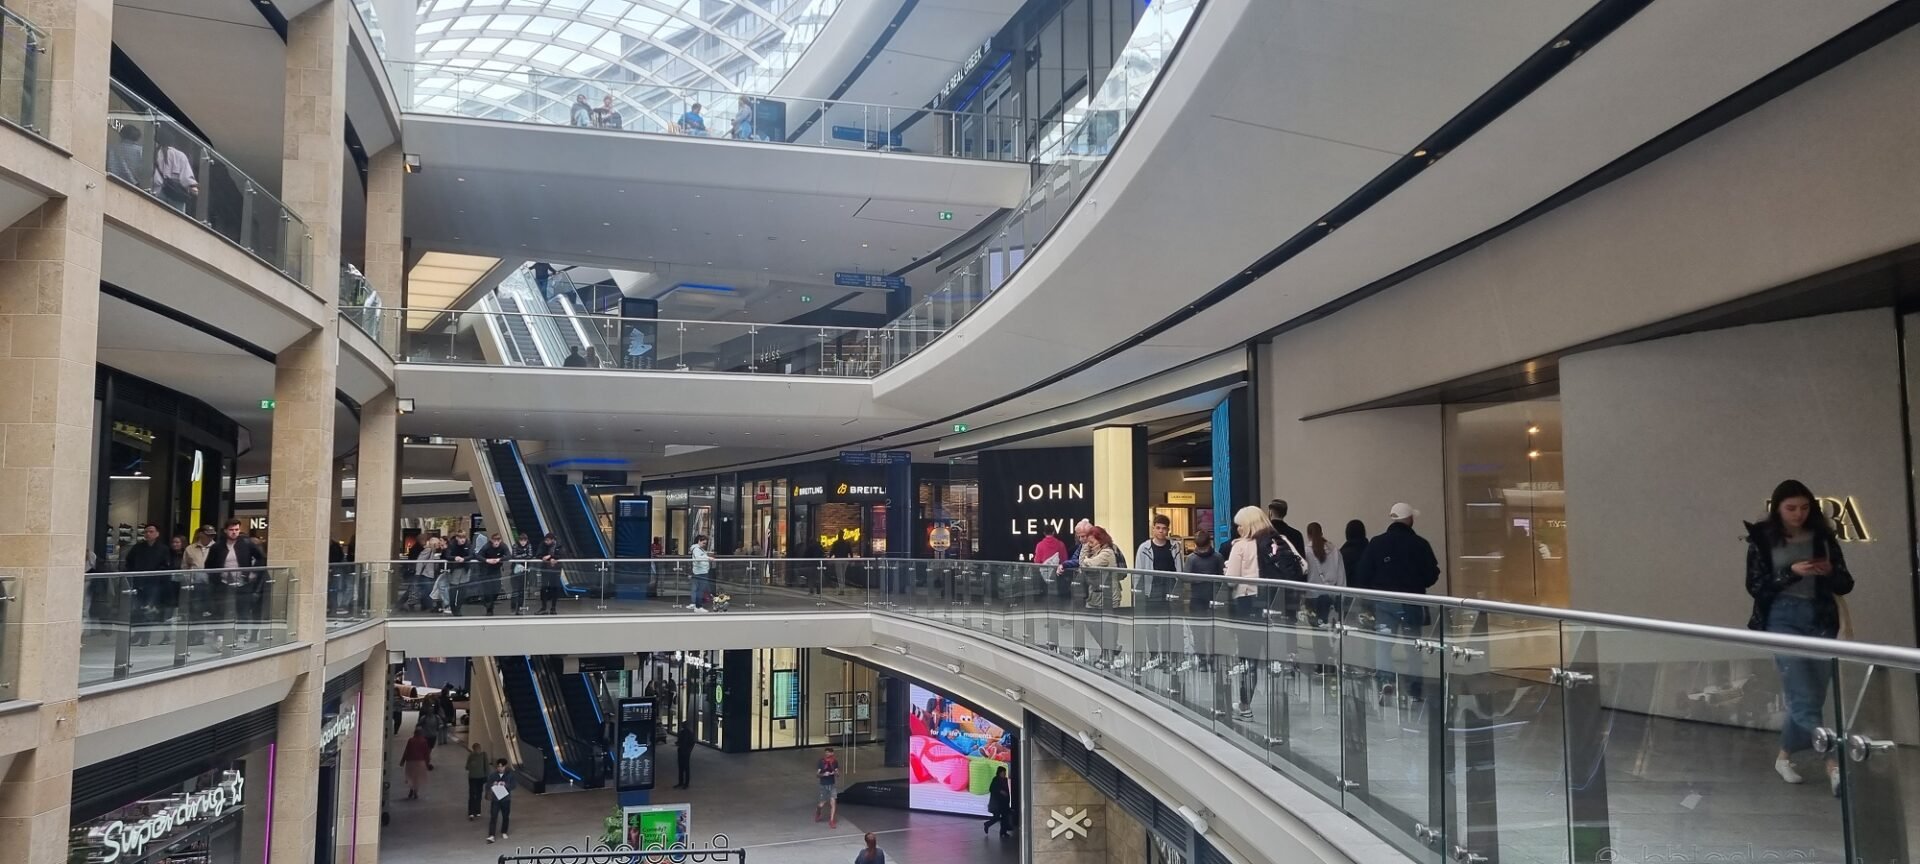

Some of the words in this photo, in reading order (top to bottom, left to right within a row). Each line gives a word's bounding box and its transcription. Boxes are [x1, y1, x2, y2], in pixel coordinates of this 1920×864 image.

[950, 68, 964, 89] REAL
[964, 46, 982, 76] GREEK
[760, 349, 780, 362] REISS
[799, 486, 824, 496] BREITLING
[1017, 483, 1084, 503] JOHN
[250, 517, 268, 529] NE
[1012, 518, 1090, 535] LEWI
[103, 787, 226, 863] Superdrug
